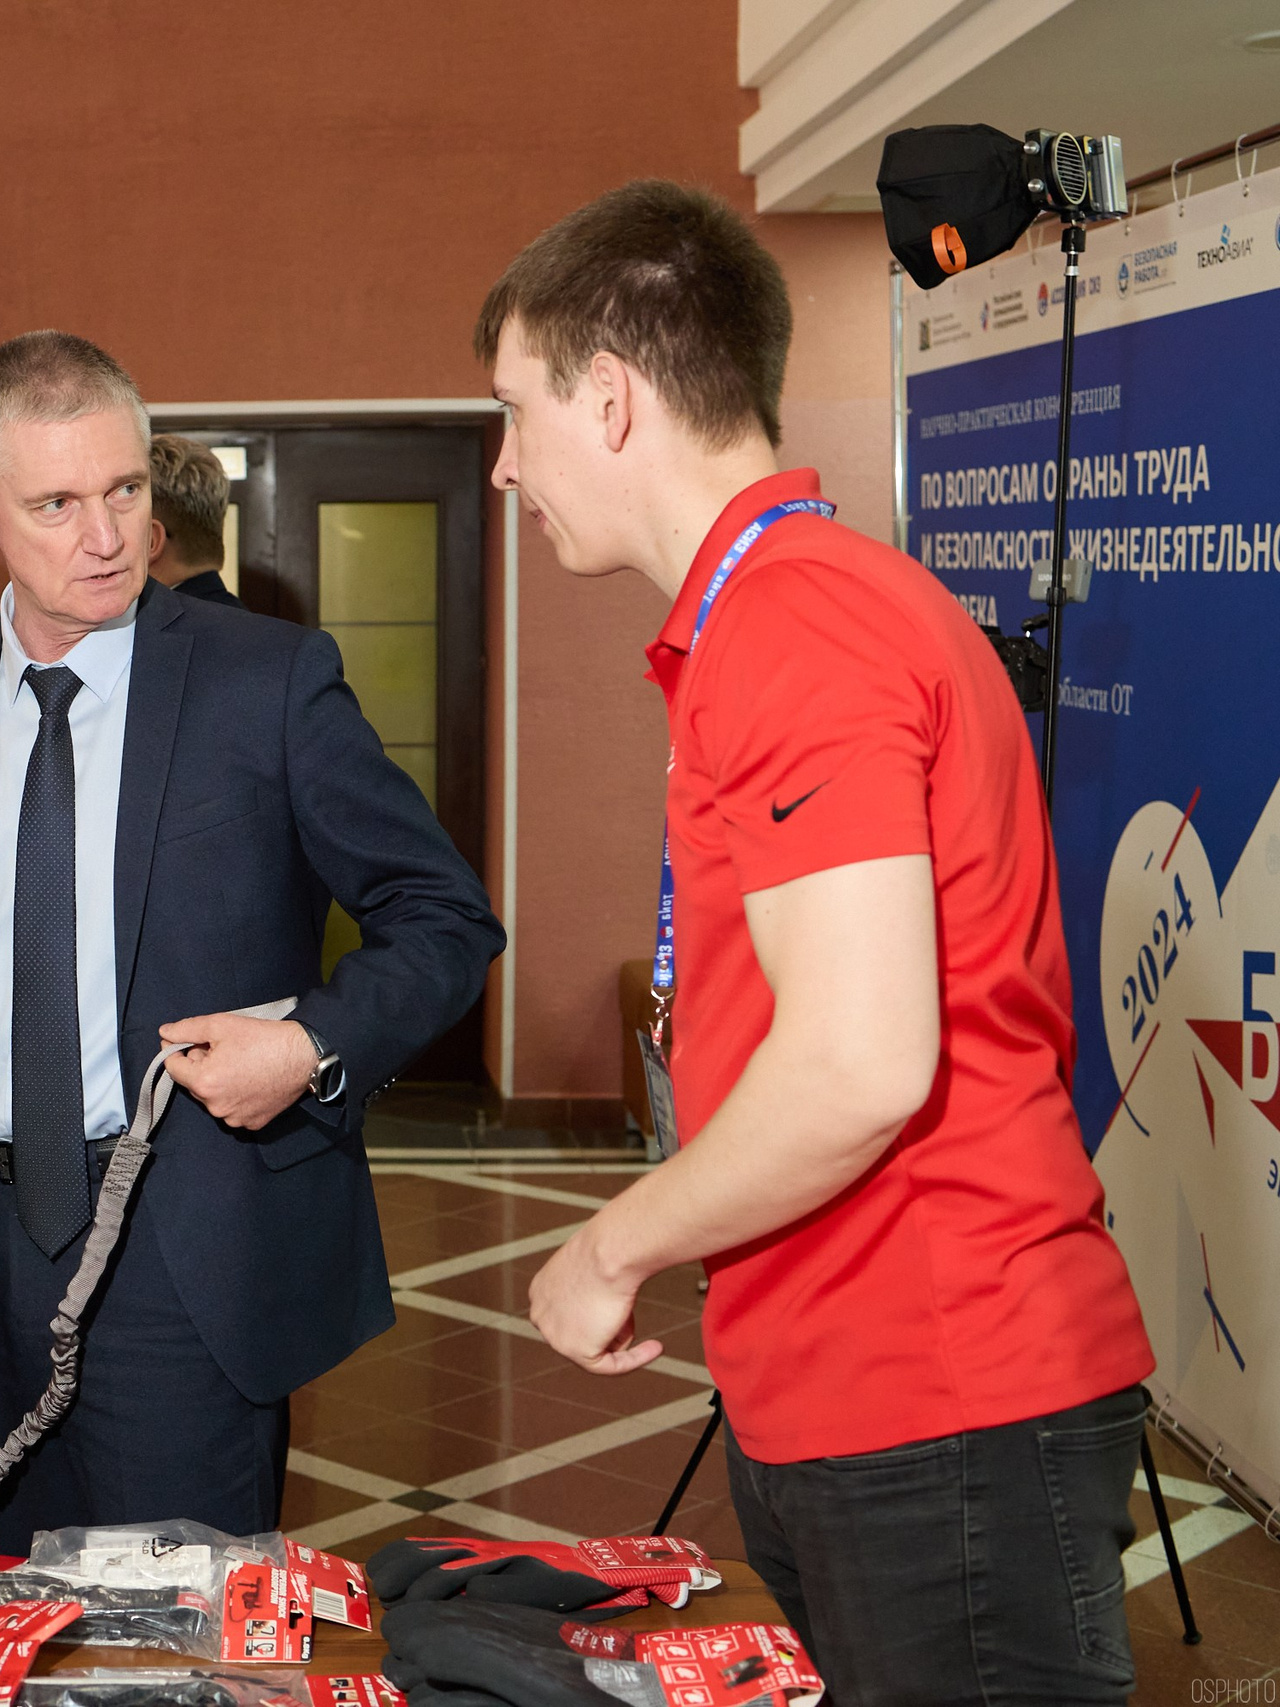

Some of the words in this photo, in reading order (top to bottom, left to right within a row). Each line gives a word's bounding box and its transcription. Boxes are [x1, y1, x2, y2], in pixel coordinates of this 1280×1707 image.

[1034, 383, 1121, 422] КОНРЕНЦИЯ
[921, 473, 942, 509] ПО
[945, 462, 1038, 508] ВОПРОСАМ
[1043, 453, 1127, 502] ОРАНЫ
[1134, 444, 1210, 504] ТРУДА
[734, 521, 763, 554] АСИЗ
[921, 532, 932, 570] И
[703, 574, 724, 604] БИОТ
[1111, 683, 1133, 716] ОТ
[658, 894, 674, 920] БИОТ
[1121, 872, 1196, 1044] 2024
[279, 1568, 287, 1597] SUPERIOR
[277, 1597, 286, 1619] SHOCK
